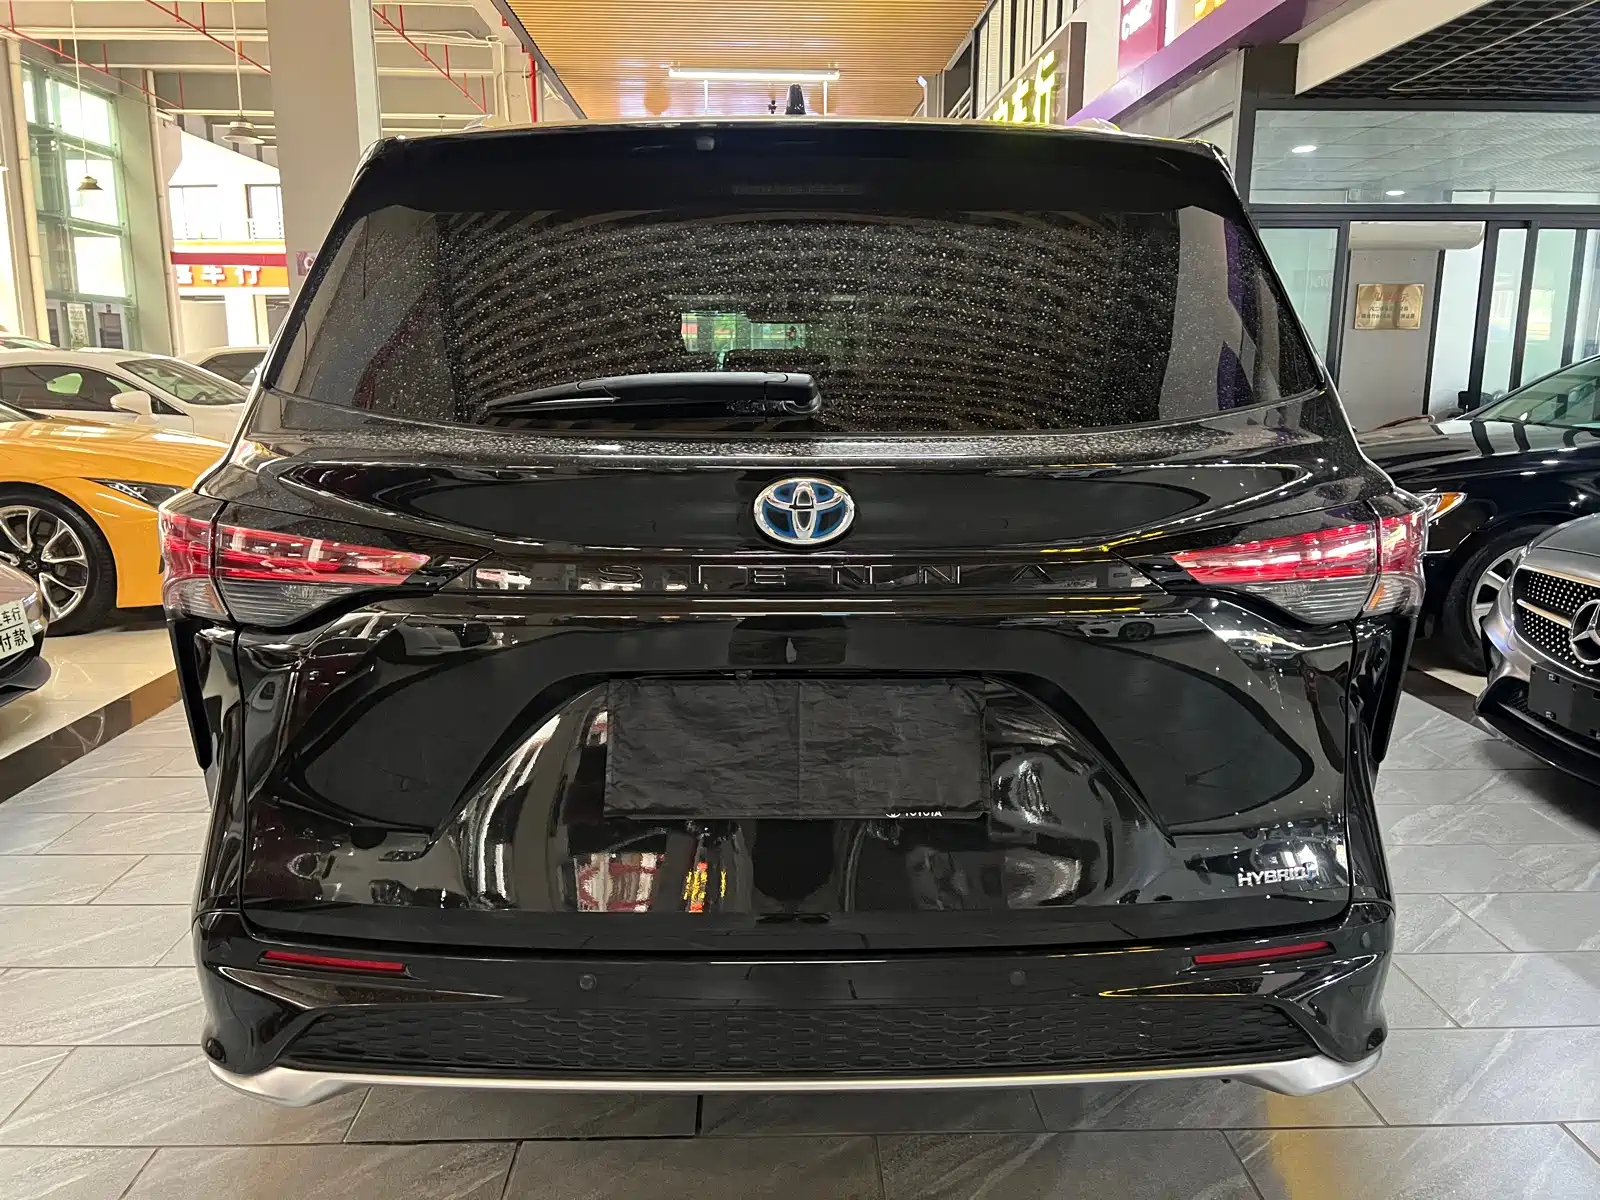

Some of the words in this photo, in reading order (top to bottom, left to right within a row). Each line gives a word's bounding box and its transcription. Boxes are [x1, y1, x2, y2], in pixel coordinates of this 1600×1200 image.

[986, 50, 1056, 124] 车行
[599, 564, 1053, 586] SIENNA
[0, 606, 21, 626] 车行
[0, 628, 29, 653] 付款
[1237, 866, 1309, 887] HYBRID
